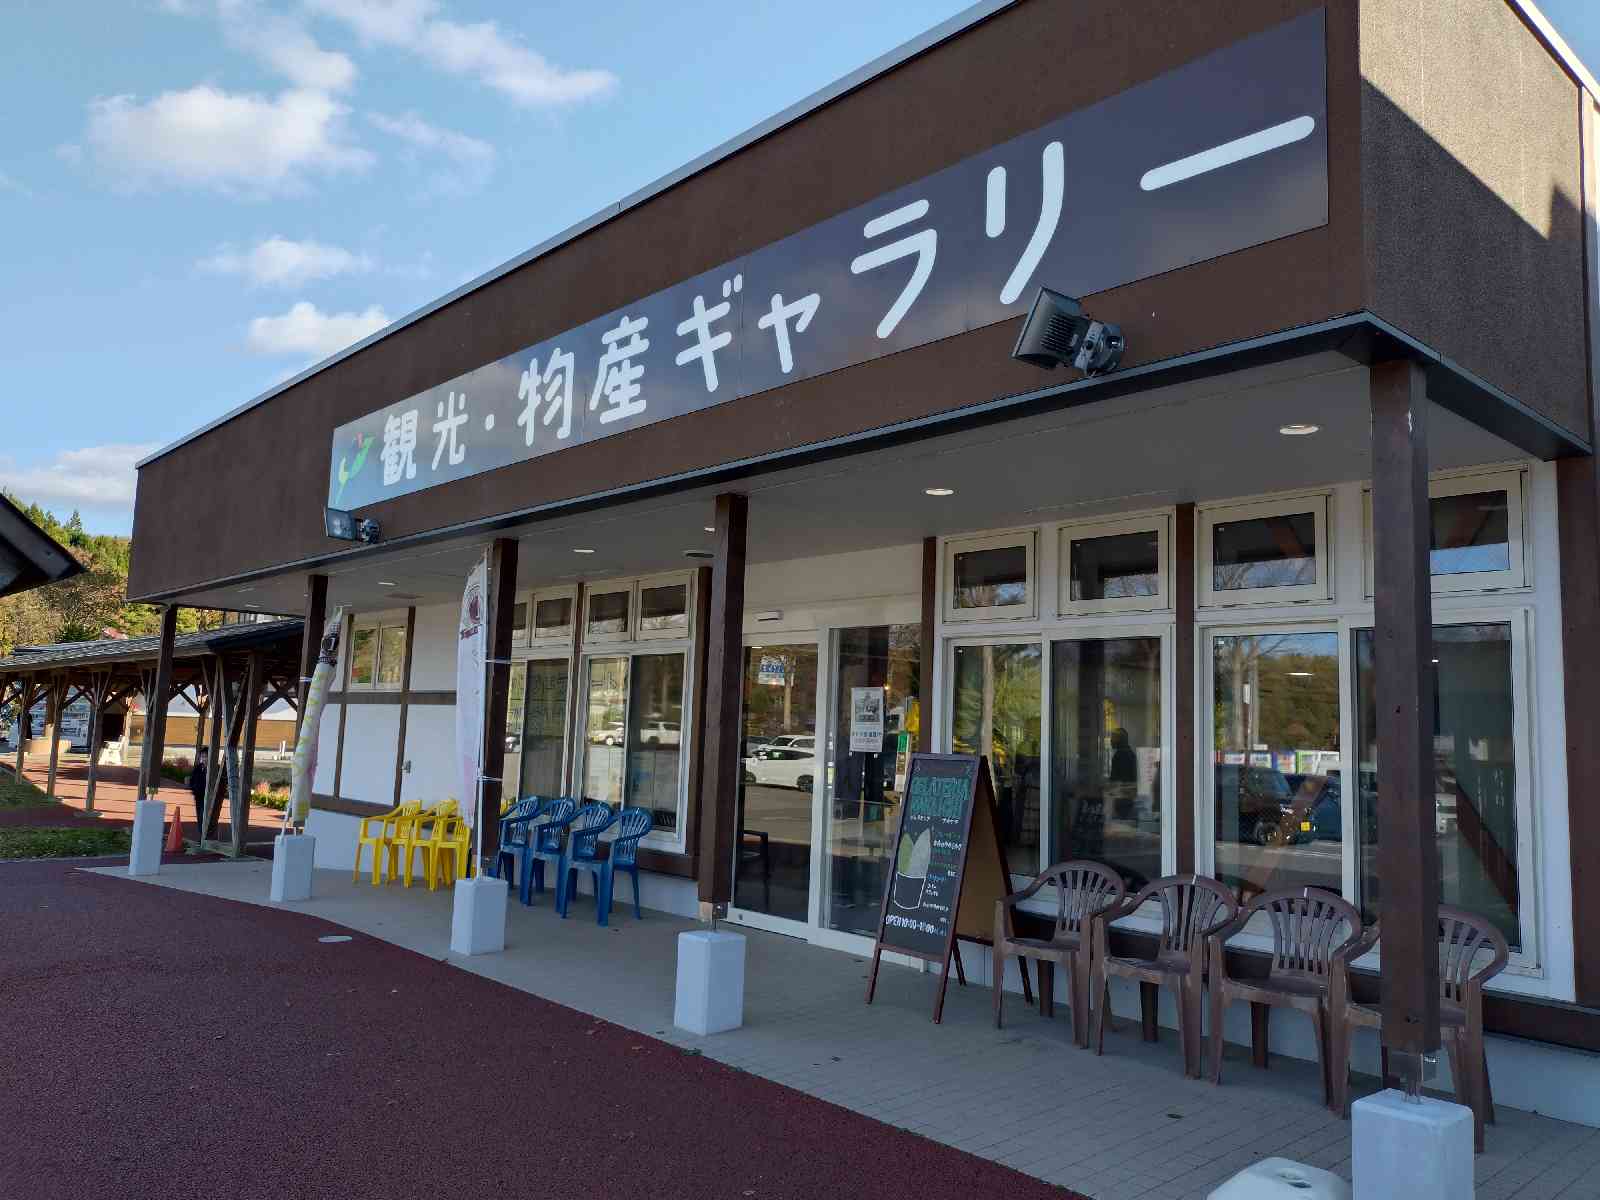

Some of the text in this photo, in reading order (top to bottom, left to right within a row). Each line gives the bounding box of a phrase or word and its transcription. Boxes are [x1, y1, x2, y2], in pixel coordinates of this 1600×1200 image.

[380, 115, 1315, 487] 観光・物産ギャラリー
